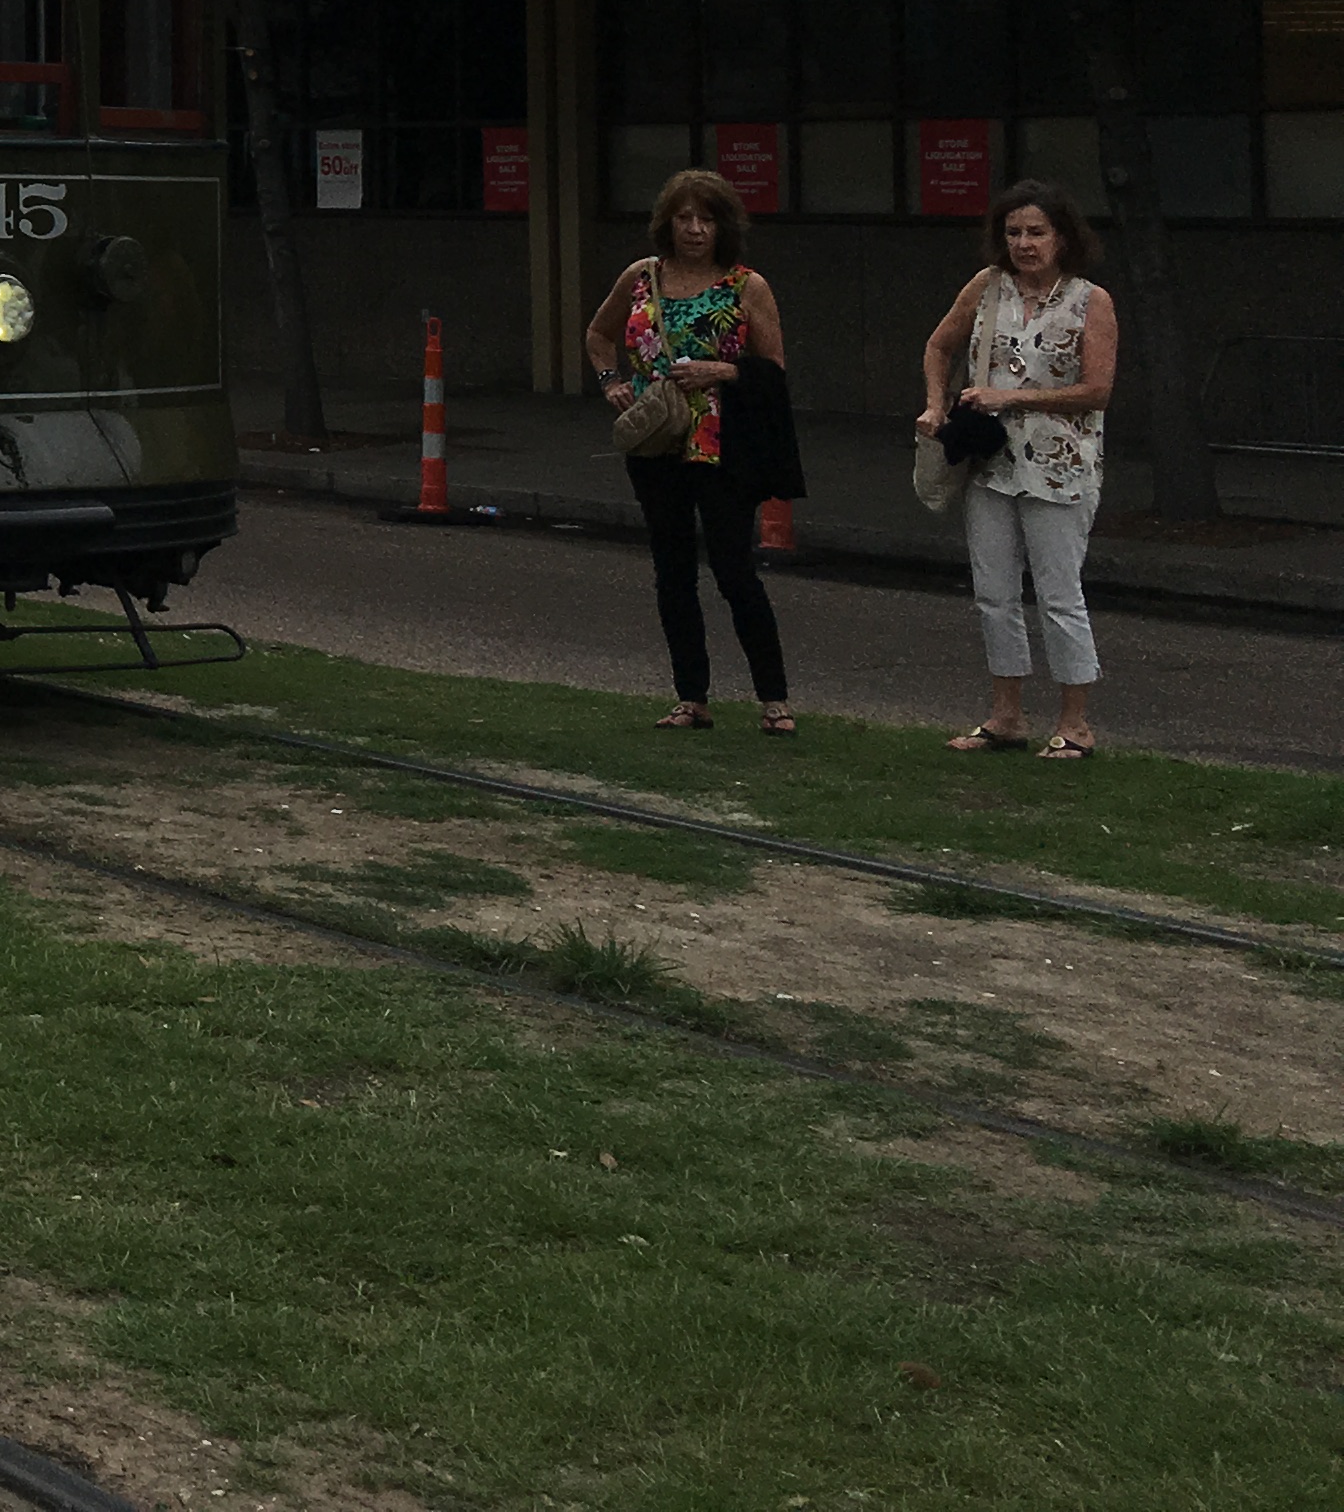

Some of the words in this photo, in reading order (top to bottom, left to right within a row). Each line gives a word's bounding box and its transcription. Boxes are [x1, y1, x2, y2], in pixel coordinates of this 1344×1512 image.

[733, 142, 761, 151] STORE
[939, 139, 969, 149] STORE
[721, 153, 773, 162] LIQUIDATION
[925, 151, 983, 160] LIQUIDATION
[499, 165, 517, 174] SALE
[736, 164, 758, 173] SALE
[942, 162, 965, 172] SALE
